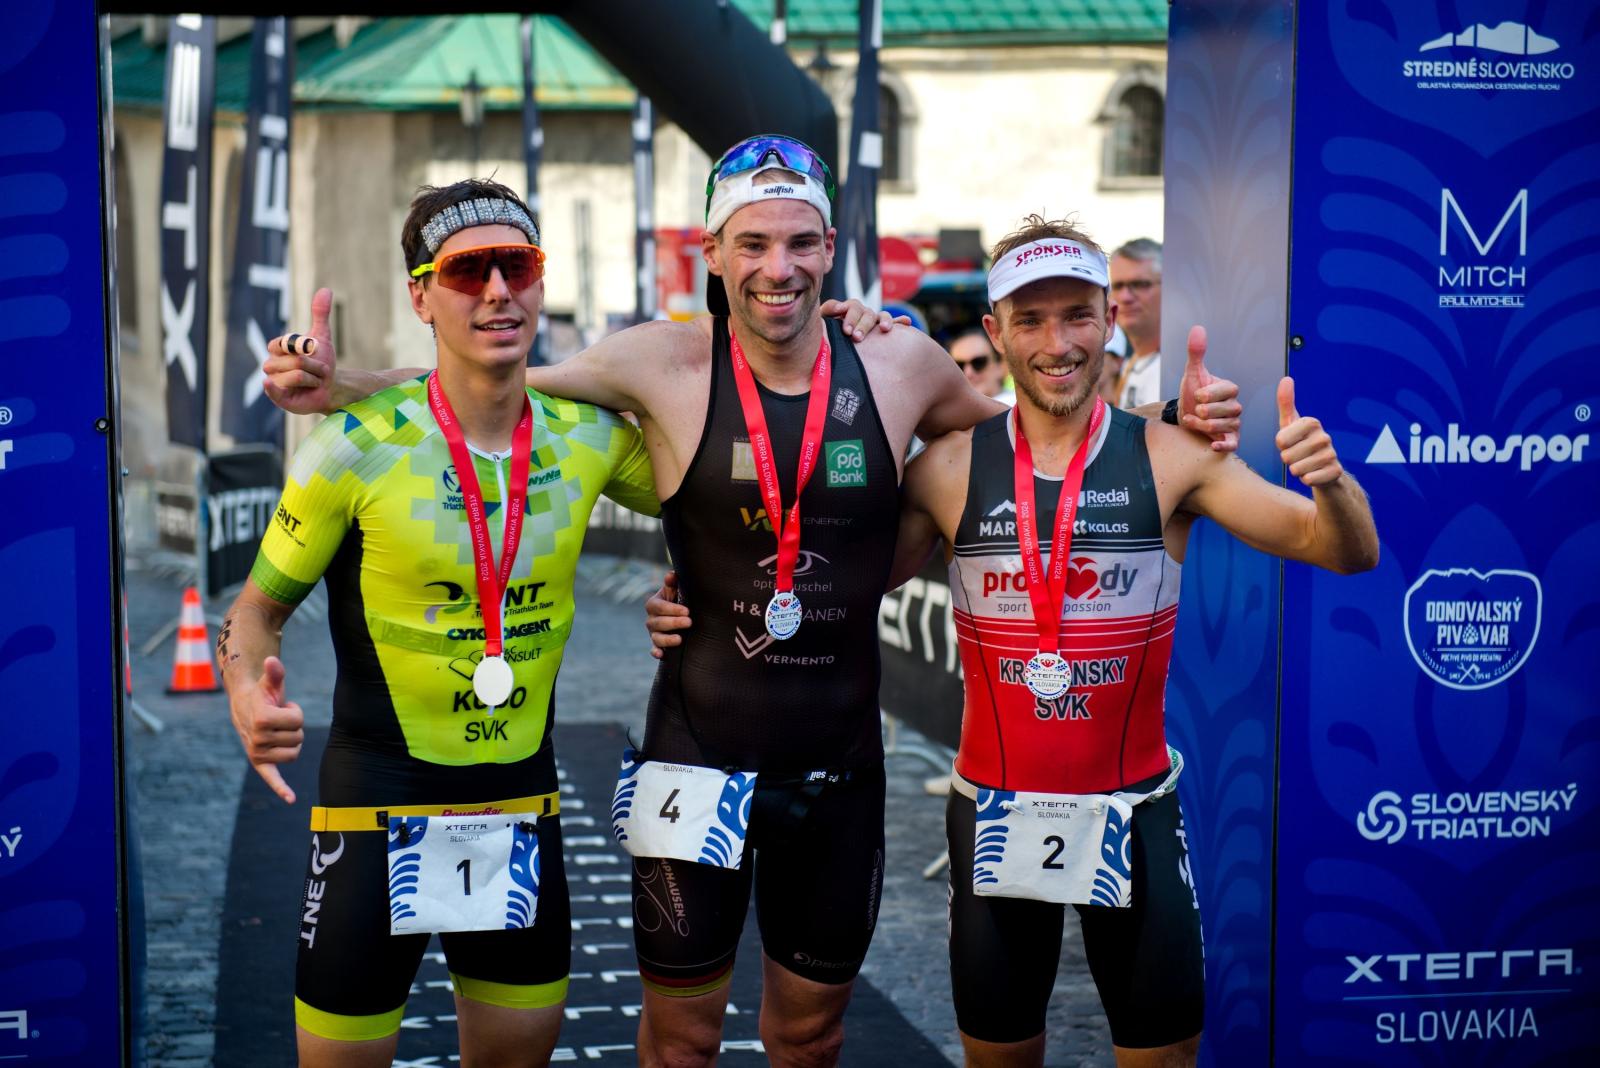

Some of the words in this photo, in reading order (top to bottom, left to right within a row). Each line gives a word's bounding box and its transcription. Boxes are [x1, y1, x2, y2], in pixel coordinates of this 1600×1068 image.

[763, 185, 794, 196] sailfish
[1016, 245, 1081, 267] SPONSER
[1439, 266, 1525, 287] MITCH
[1439, 296, 1468, 307] PAUL
[1469, 296, 1524, 307] MITCHELL
[755, 433, 768, 462] XTERRA
[1409, 422, 1590, 471] inkospor
[761, 462, 775, 499] SLOVAKIA
[830, 470, 864, 484] Bank
[442, 502, 466, 511] Triath
[1087, 486, 1130, 506] Redaj
[468, 494, 480, 523] XTERRA
[511, 498, 520, 517] 2024
[1021, 501, 1029, 519] 2024
[1062, 496, 1073, 522] XTERRA
[979, 521, 1017, 537] MAR
[1022, 520, 1034, 555] SLOVAKIA
[475, 523, 487, 560] SLOVAKIA
[1056, 523, 1068, 559] SLOVAKIA
[480, 562, 490, 581] 2024
[1028, 557, 1039, 584] XTERRA
[1054, 561, 1063, 579] 2024
[997, 602, 1027, 615] sport
[1063, 601, 1111, 615] passion
[1426, 597, 1522, 622] DONOVALSKÝ
[447, 618, 551, 641] CYKOAGENT
[764, 654, 835, 665] VERMENTO
[1030, 672, 1066, 680] XTERRA
[1034, 692, 1093, 721] SVK
[464, 720, 509, 743] SVK
[663, 764, 693, 774] SLOVAKIA
[659, 788, 680, 824] 4
[1032, 801, 1078, 809] XTERRA
[1411, 783, 1577, 815] SLOVENSKÝ
[1037, 811, 1071, 820] SLOVAKIA
[445, 823, 488, 831] XTERRA
[1411, 816, 1550, 840] TRIATLON
[1042, 835, 1065, 870] 2
[456, 859, 471, 896] 1
[1343, 948, 1574, 983] XTERRA
[1376, 1007, 1539, 1043] SLOVAKIA
